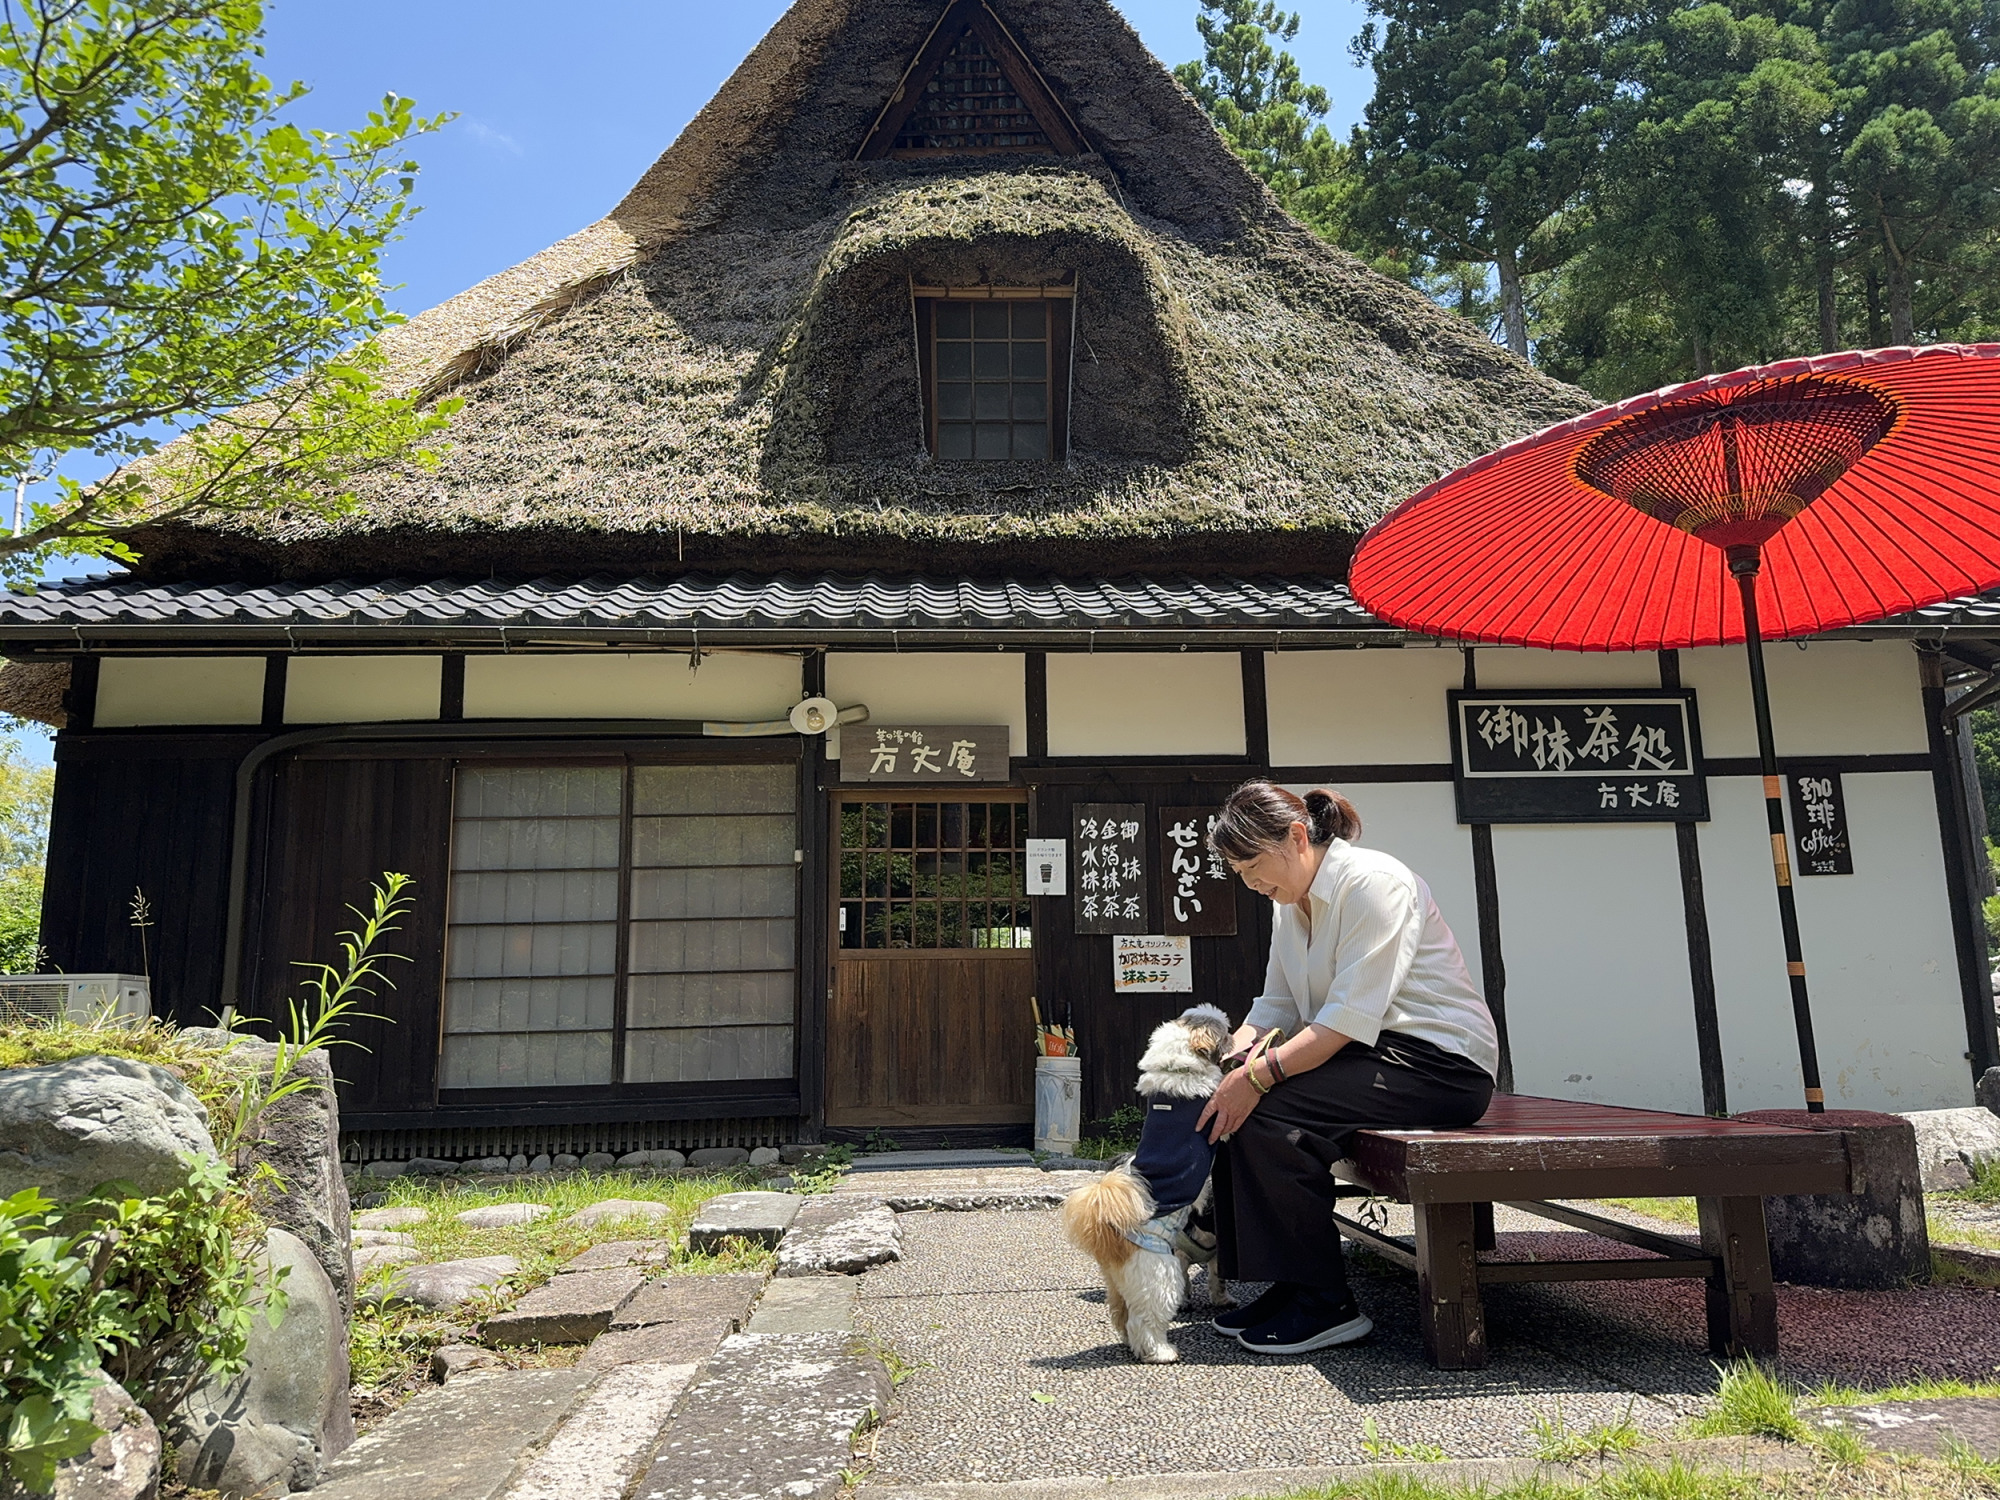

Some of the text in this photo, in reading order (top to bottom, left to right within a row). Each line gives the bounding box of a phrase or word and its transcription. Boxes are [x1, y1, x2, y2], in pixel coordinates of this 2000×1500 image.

[869, 740, 977, 777] 方丈庵
[1477, 705, 1676, 772] 御抹茶処
[1597, 780, 1680, 809] 方丈庵
[1798, 777, 1836, 830] 珈琲
[1080, 817, 1100, 922] 冷水抹茶
[1101, 818, 1121, 920] 金箔抹茶
[1120, 819, 1142, 921] 御抹茶
[1166, 819, 1202, 923] ぜんざい
[1118, 951, 1185, 967] 加賀抹茶ラテ
[1122, 968, 1171, 984] 抹茶ラテ
